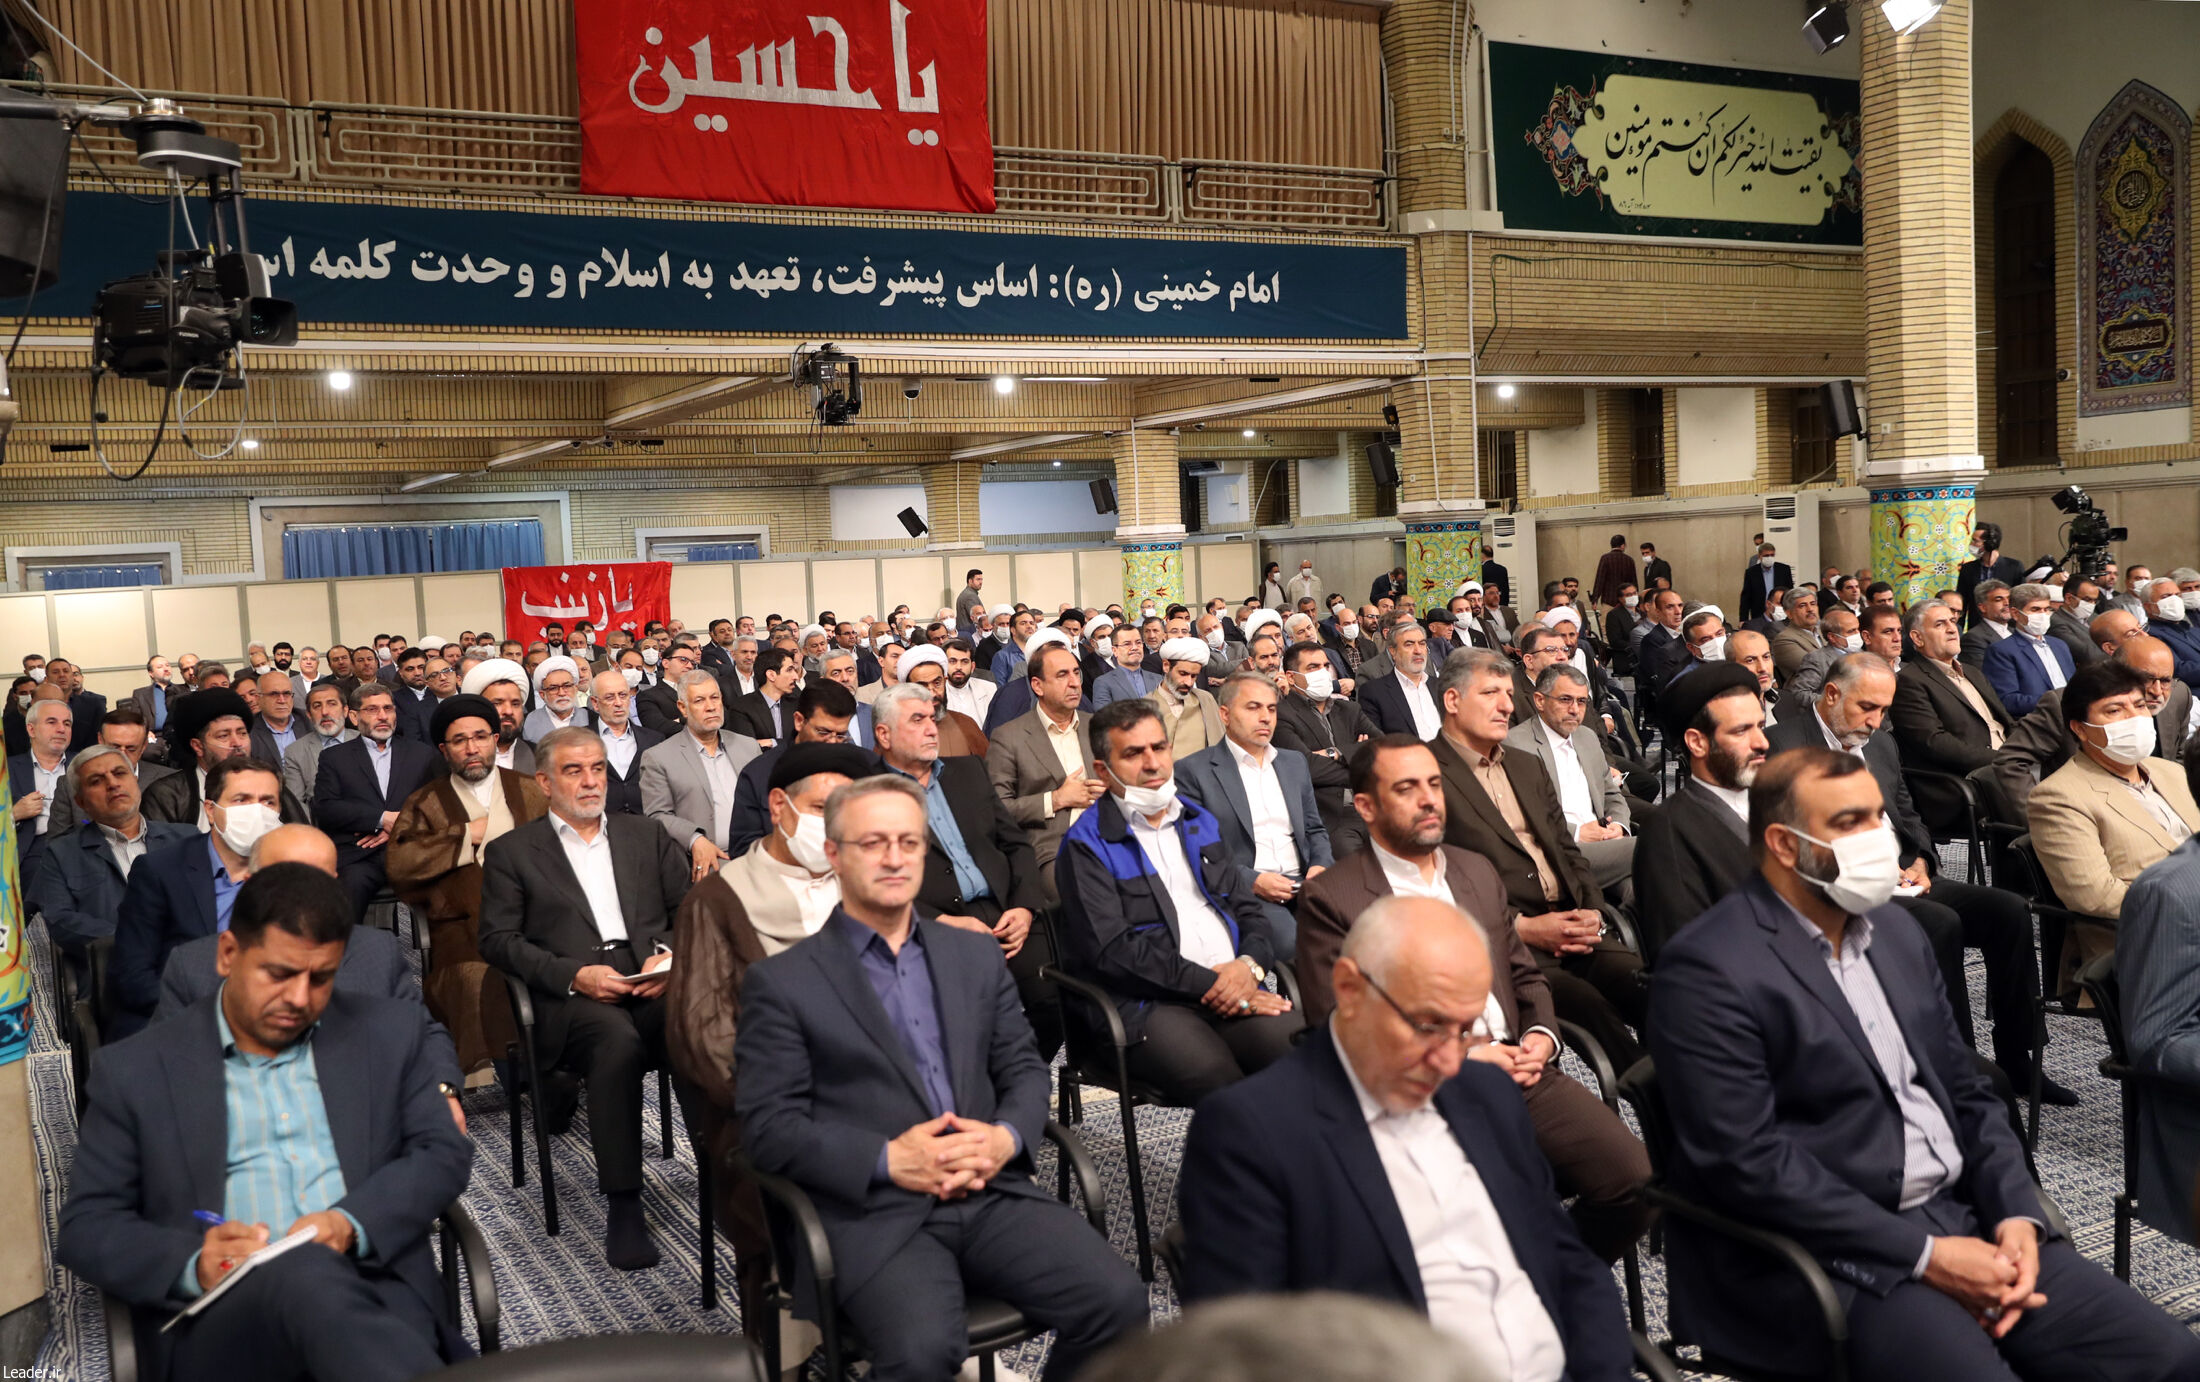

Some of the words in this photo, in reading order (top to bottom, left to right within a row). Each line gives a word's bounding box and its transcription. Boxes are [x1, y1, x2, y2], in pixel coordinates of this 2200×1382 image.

[309, 237, 396, 280] کلمه
[411, 250, 535, 299] وحدت
[578, 247, 671, 300] اسلام
[682, 259, 714, 300] به
[729, 256, 802, 299] تعهد
[546, 264, 567, 299] و
[956, 260, 1038, 309] اساس
[1133, 269, 1221, 313] خمینی
[1228, 270, 1281, 313] امام
